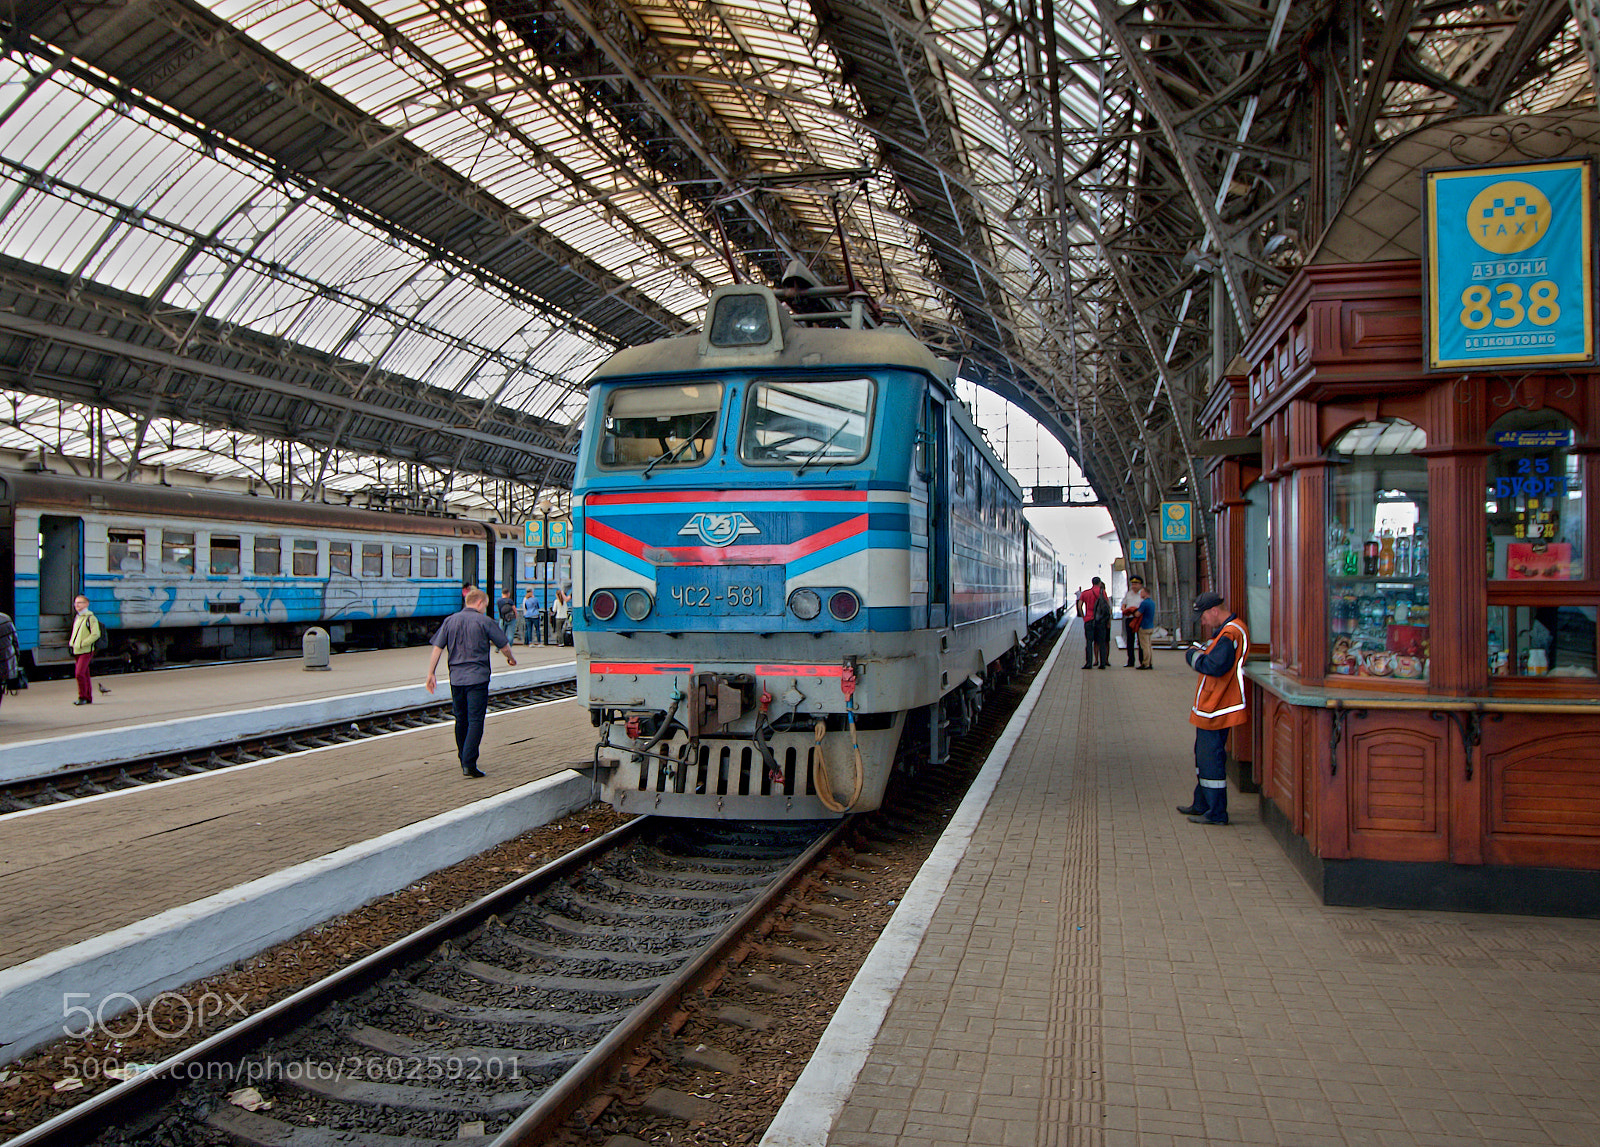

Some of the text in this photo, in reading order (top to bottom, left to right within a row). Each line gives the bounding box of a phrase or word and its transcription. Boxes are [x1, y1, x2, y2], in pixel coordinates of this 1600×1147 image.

[1479, 220, 1539, 237] TAXI
[1472, 260, 1547, 277] ДЗВОНИ
[1459, 280, 1561, 330] 838
[1518, 457, 1550, 473] 25
[1494, 476, 1570, 498] БУФЕТ
[1167, 525, 1187, 535] 838
[671, 585, 764, 608] ЧС2-581
